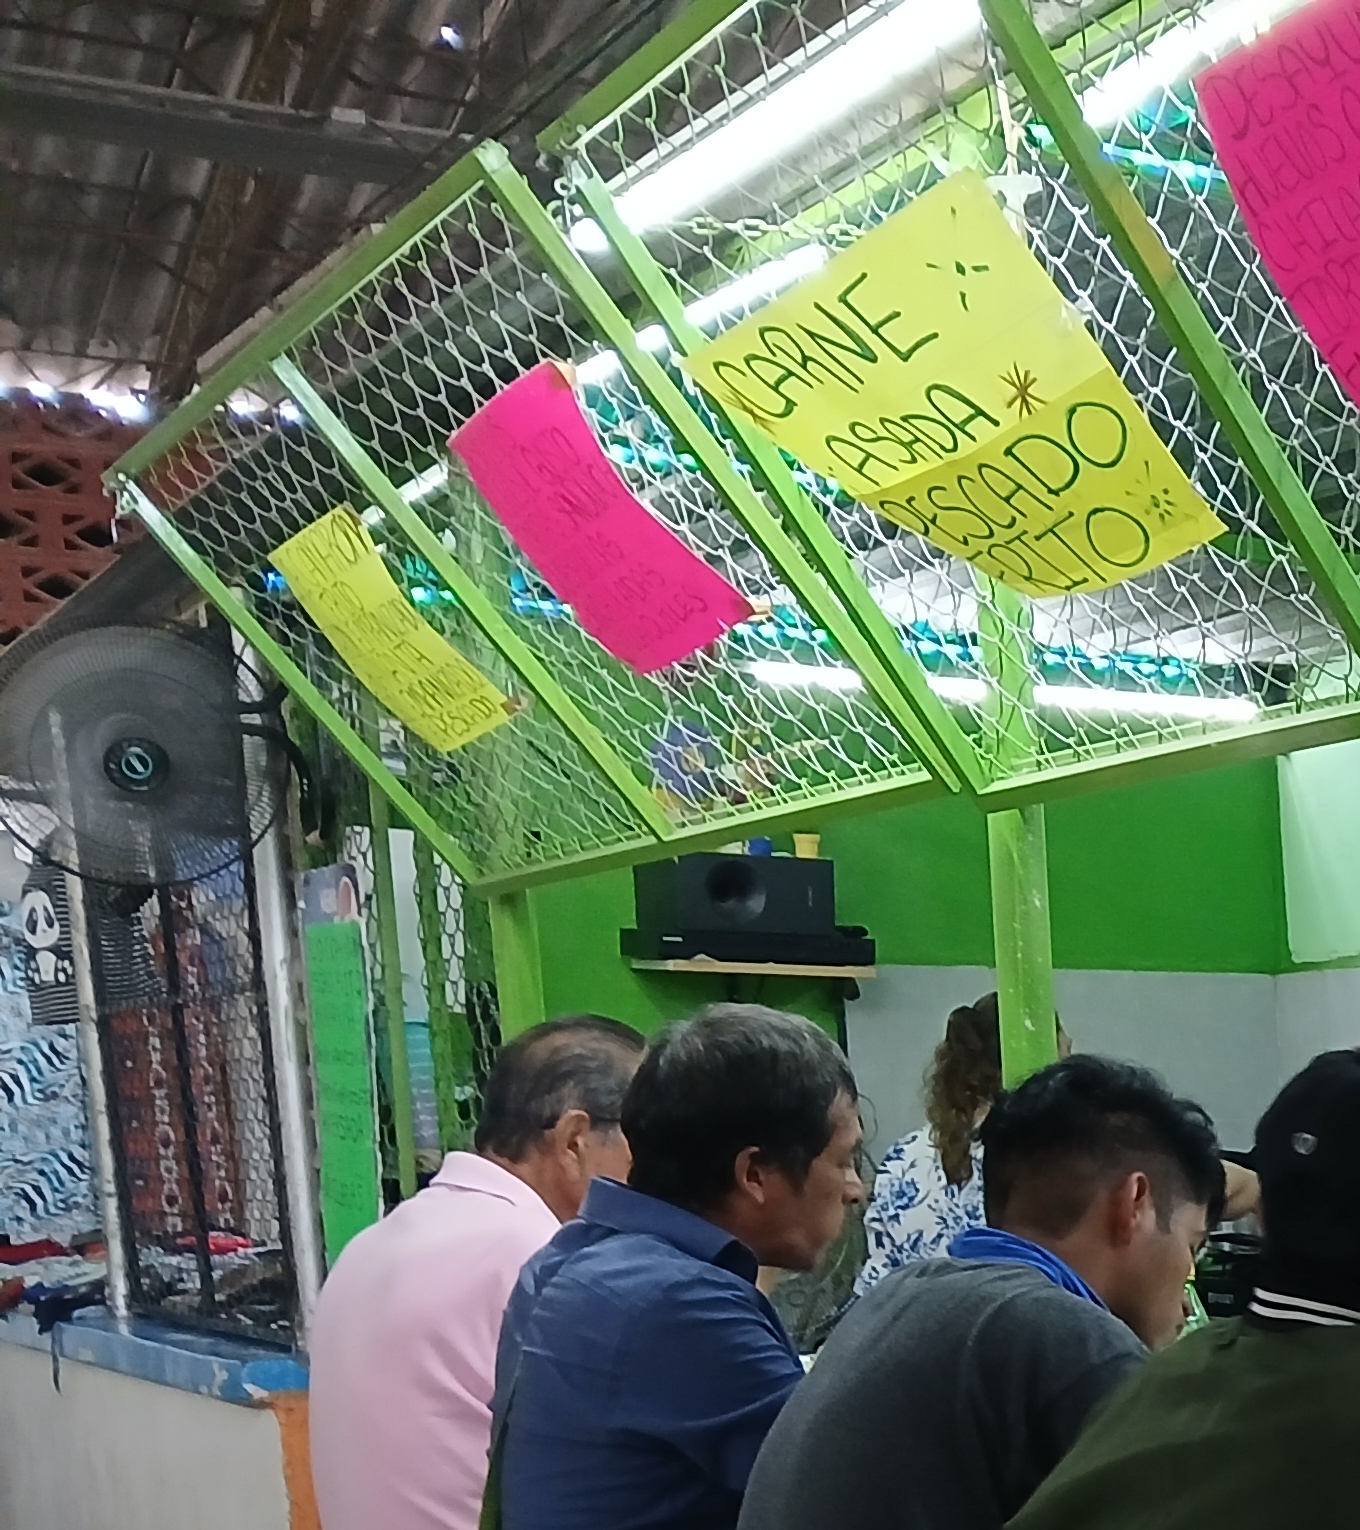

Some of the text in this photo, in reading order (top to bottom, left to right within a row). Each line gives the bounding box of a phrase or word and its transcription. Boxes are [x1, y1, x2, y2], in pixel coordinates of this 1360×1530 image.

[713, 272, 939, 420] CARNE
[825, 383, 1000, 487] ASADA
[879, 401, 1128, 548] PESCADO
